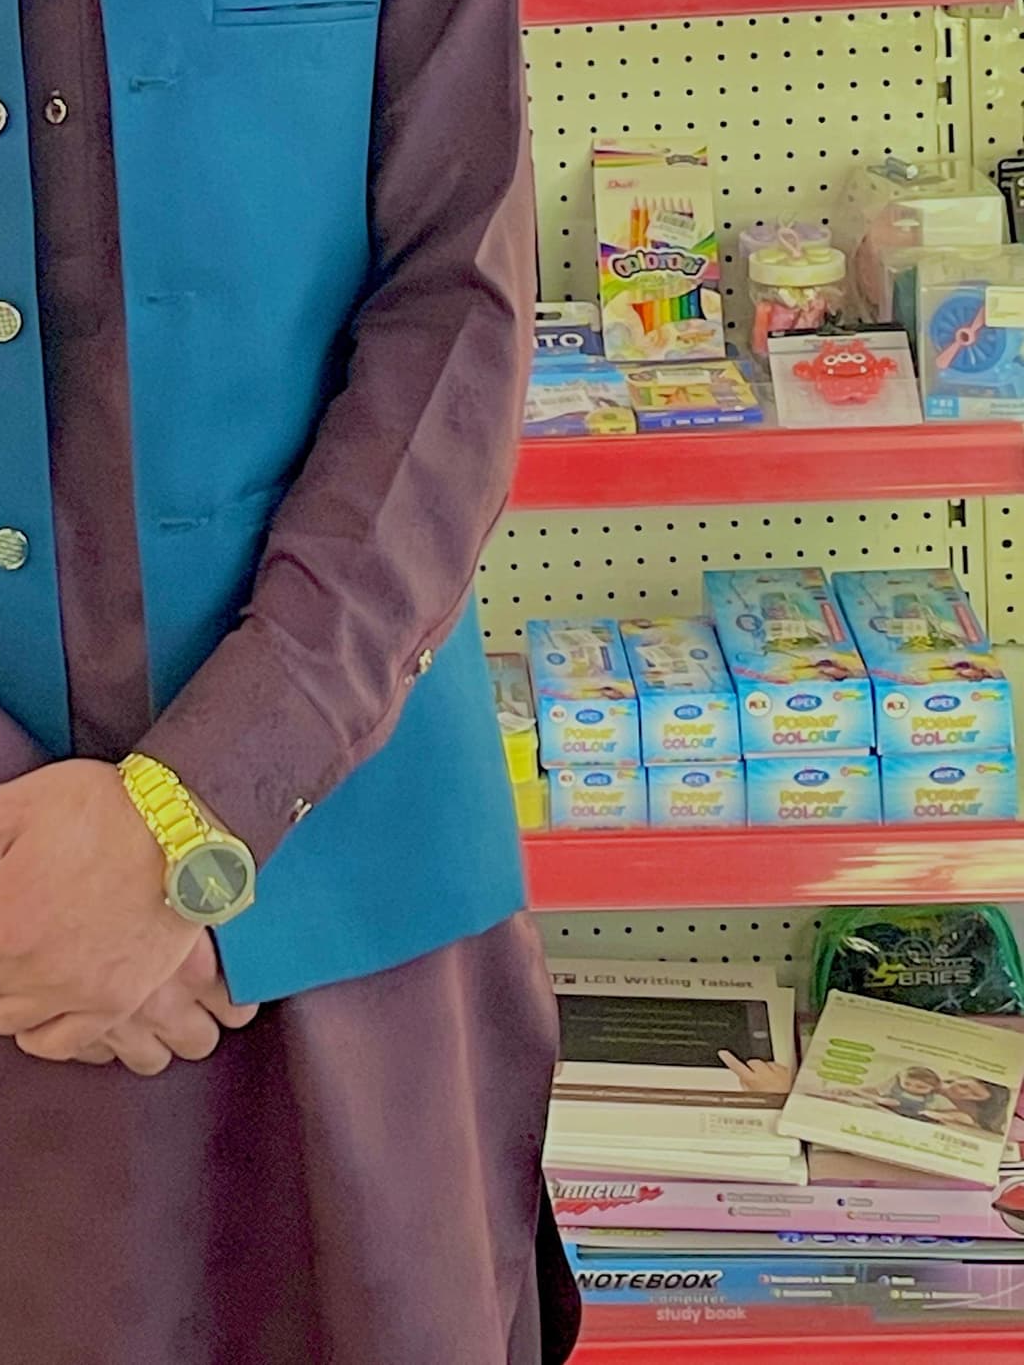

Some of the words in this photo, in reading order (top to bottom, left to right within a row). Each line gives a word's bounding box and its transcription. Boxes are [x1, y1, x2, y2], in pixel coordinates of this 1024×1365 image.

[789, 696, 818, 708] APEX
[583, 974, 617, 985] LCD
[623, 974, 692, 988] Writing
[697, 977, 754, 989] Tablet
[576, 1272, 719, 1290] NOTEBOOK
[655, 1306, 701, 1325] study
[704, 1306, 747, 1322] book
